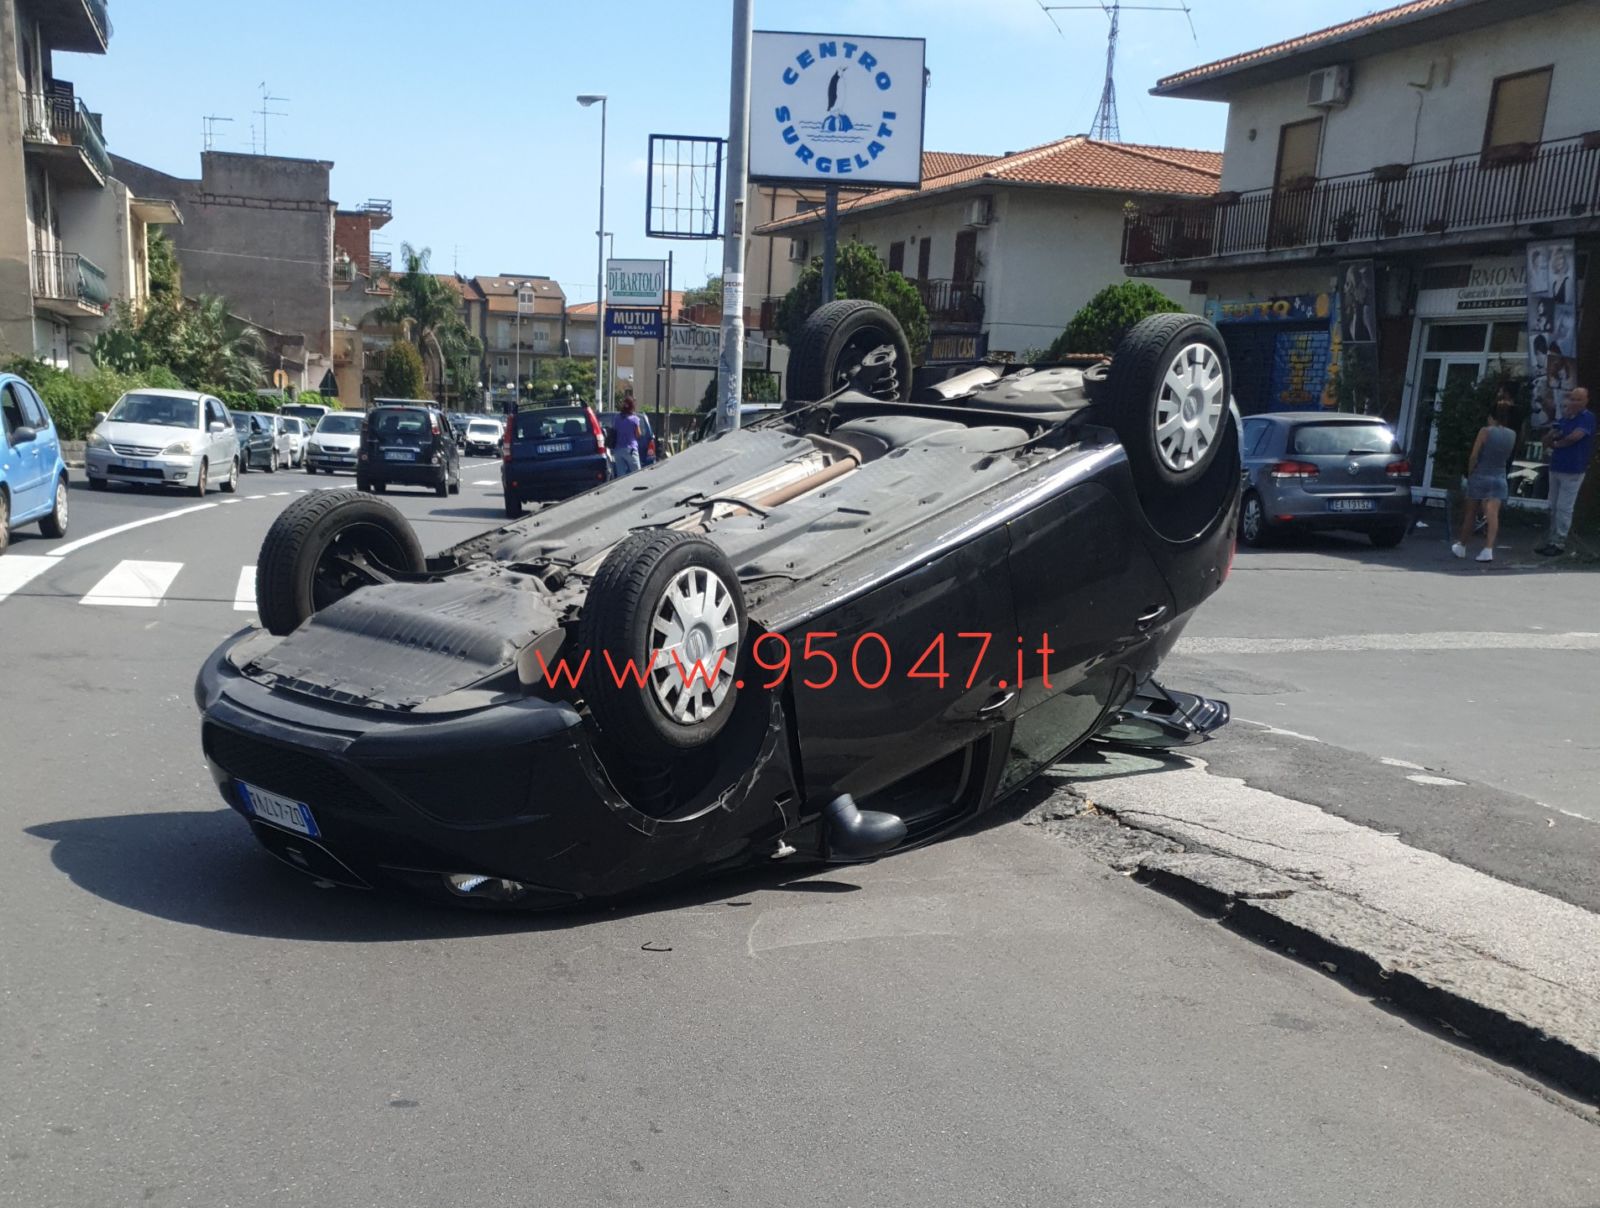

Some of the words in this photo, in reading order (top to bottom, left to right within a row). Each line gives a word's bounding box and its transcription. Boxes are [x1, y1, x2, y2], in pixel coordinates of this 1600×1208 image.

[782, 41, 892, 90] CENTRO
[775, 105, 897, 174] SURGELATI
[608, 271, 618, 291] DI
[620, 271, 661, 292] BARTOLO
[613, 311, 655, 325] MUTUI
